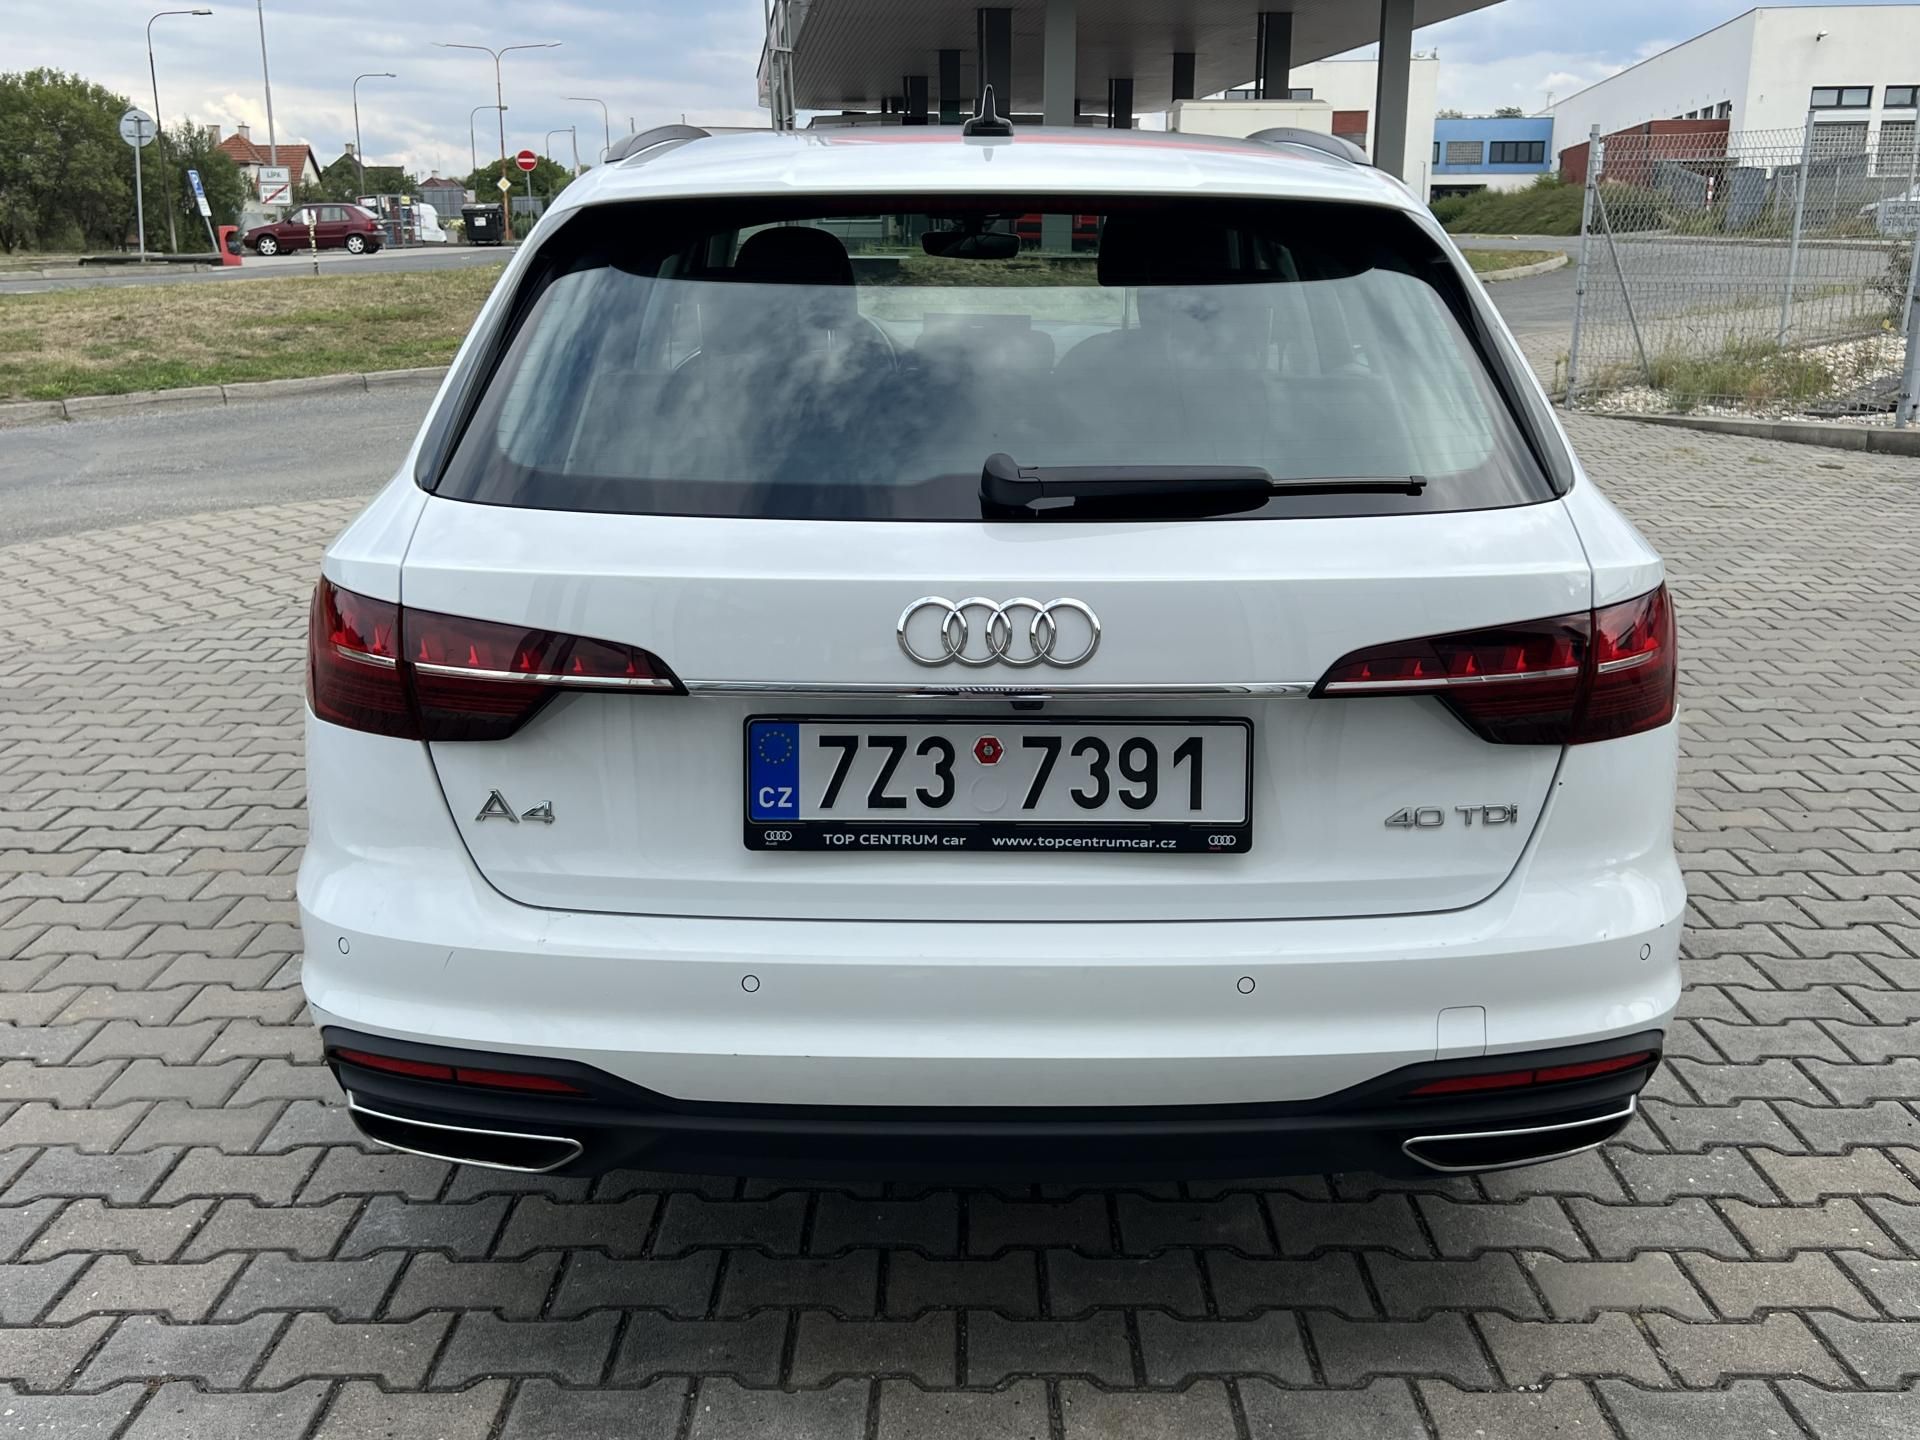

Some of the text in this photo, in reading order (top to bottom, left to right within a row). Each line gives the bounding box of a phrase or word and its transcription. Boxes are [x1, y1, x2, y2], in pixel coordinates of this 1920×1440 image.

[818, 735, 1203, 810] 7Z3 7391
[475, 788, 555, 825] A4
[758, 787, 793, 808] CZ
[1384, 803, 1518, 827] 40 TDI
[823, 833, 967, 846] TOP CENTRUM car
[992, 836, 1177, 849] www.topcentrumcar.cz
